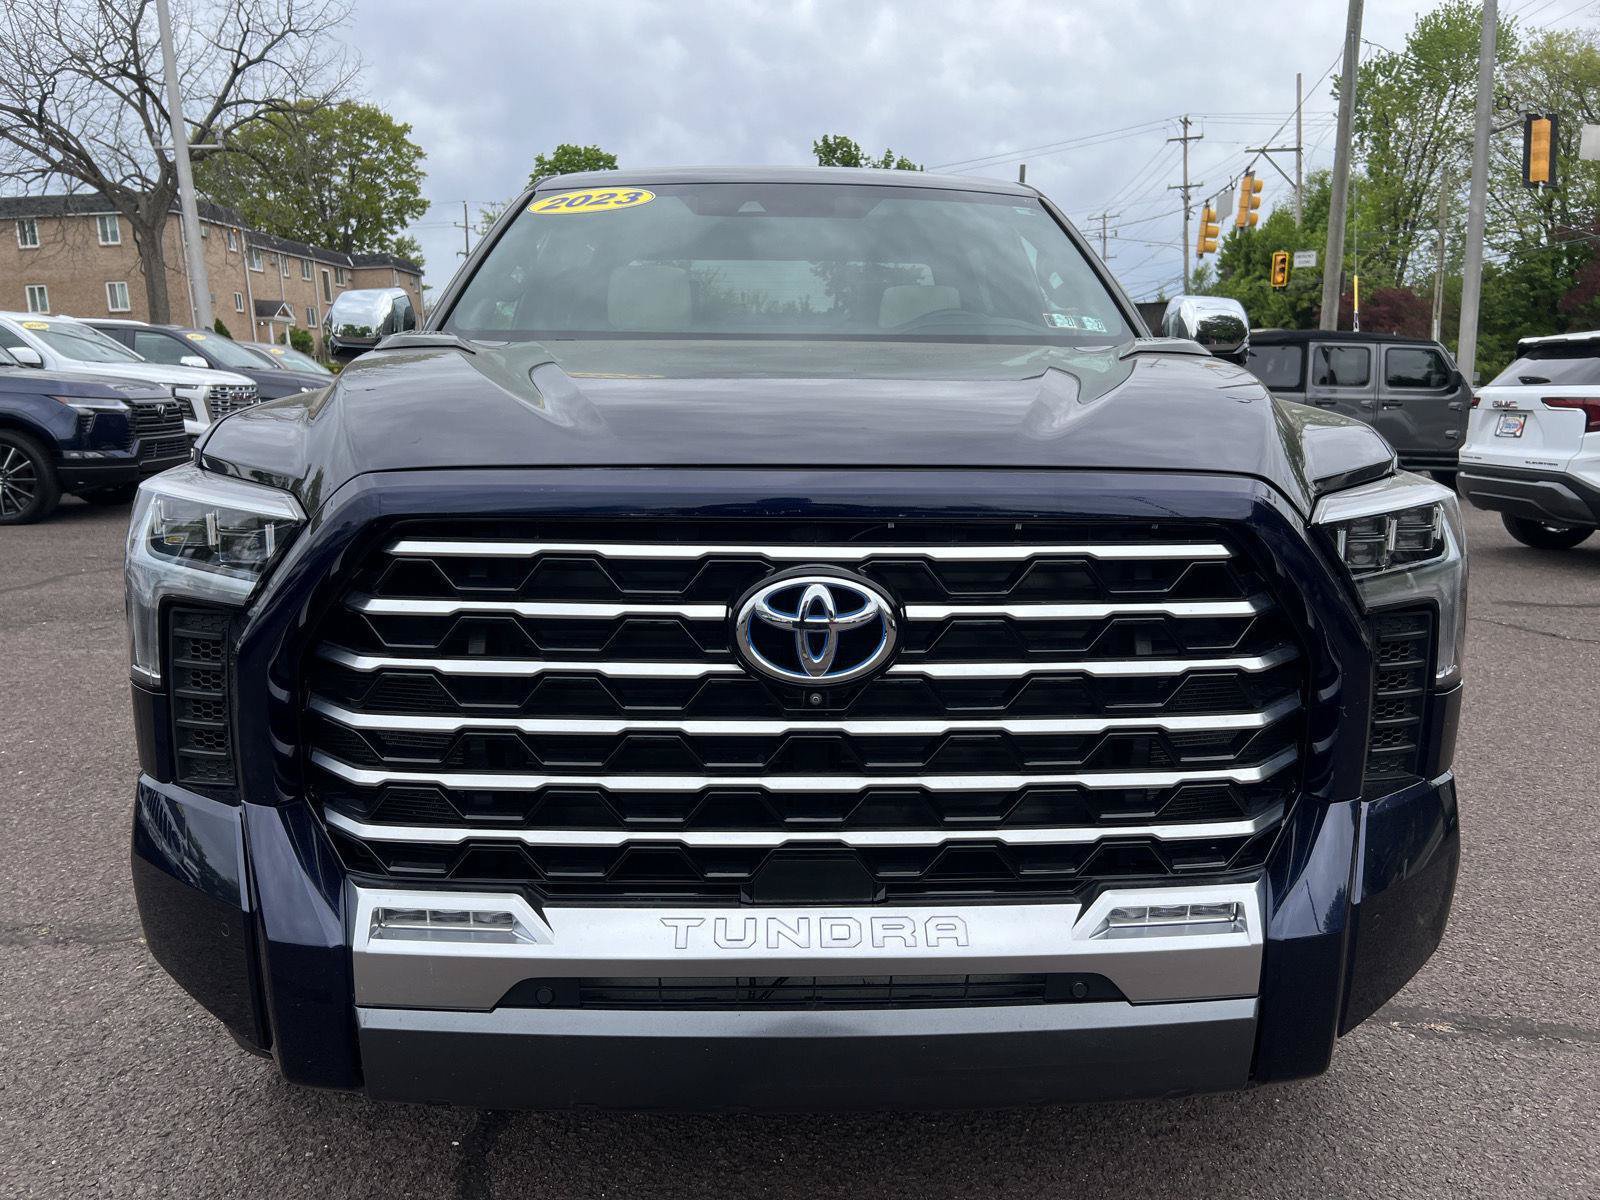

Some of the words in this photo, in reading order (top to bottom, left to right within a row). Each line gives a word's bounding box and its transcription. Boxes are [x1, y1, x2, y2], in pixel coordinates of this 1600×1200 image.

[537, 192, 643, 211] 2023
[1492, 400, 1518, 409] GMC
[659, 915, 969, 949] TUNDRA
